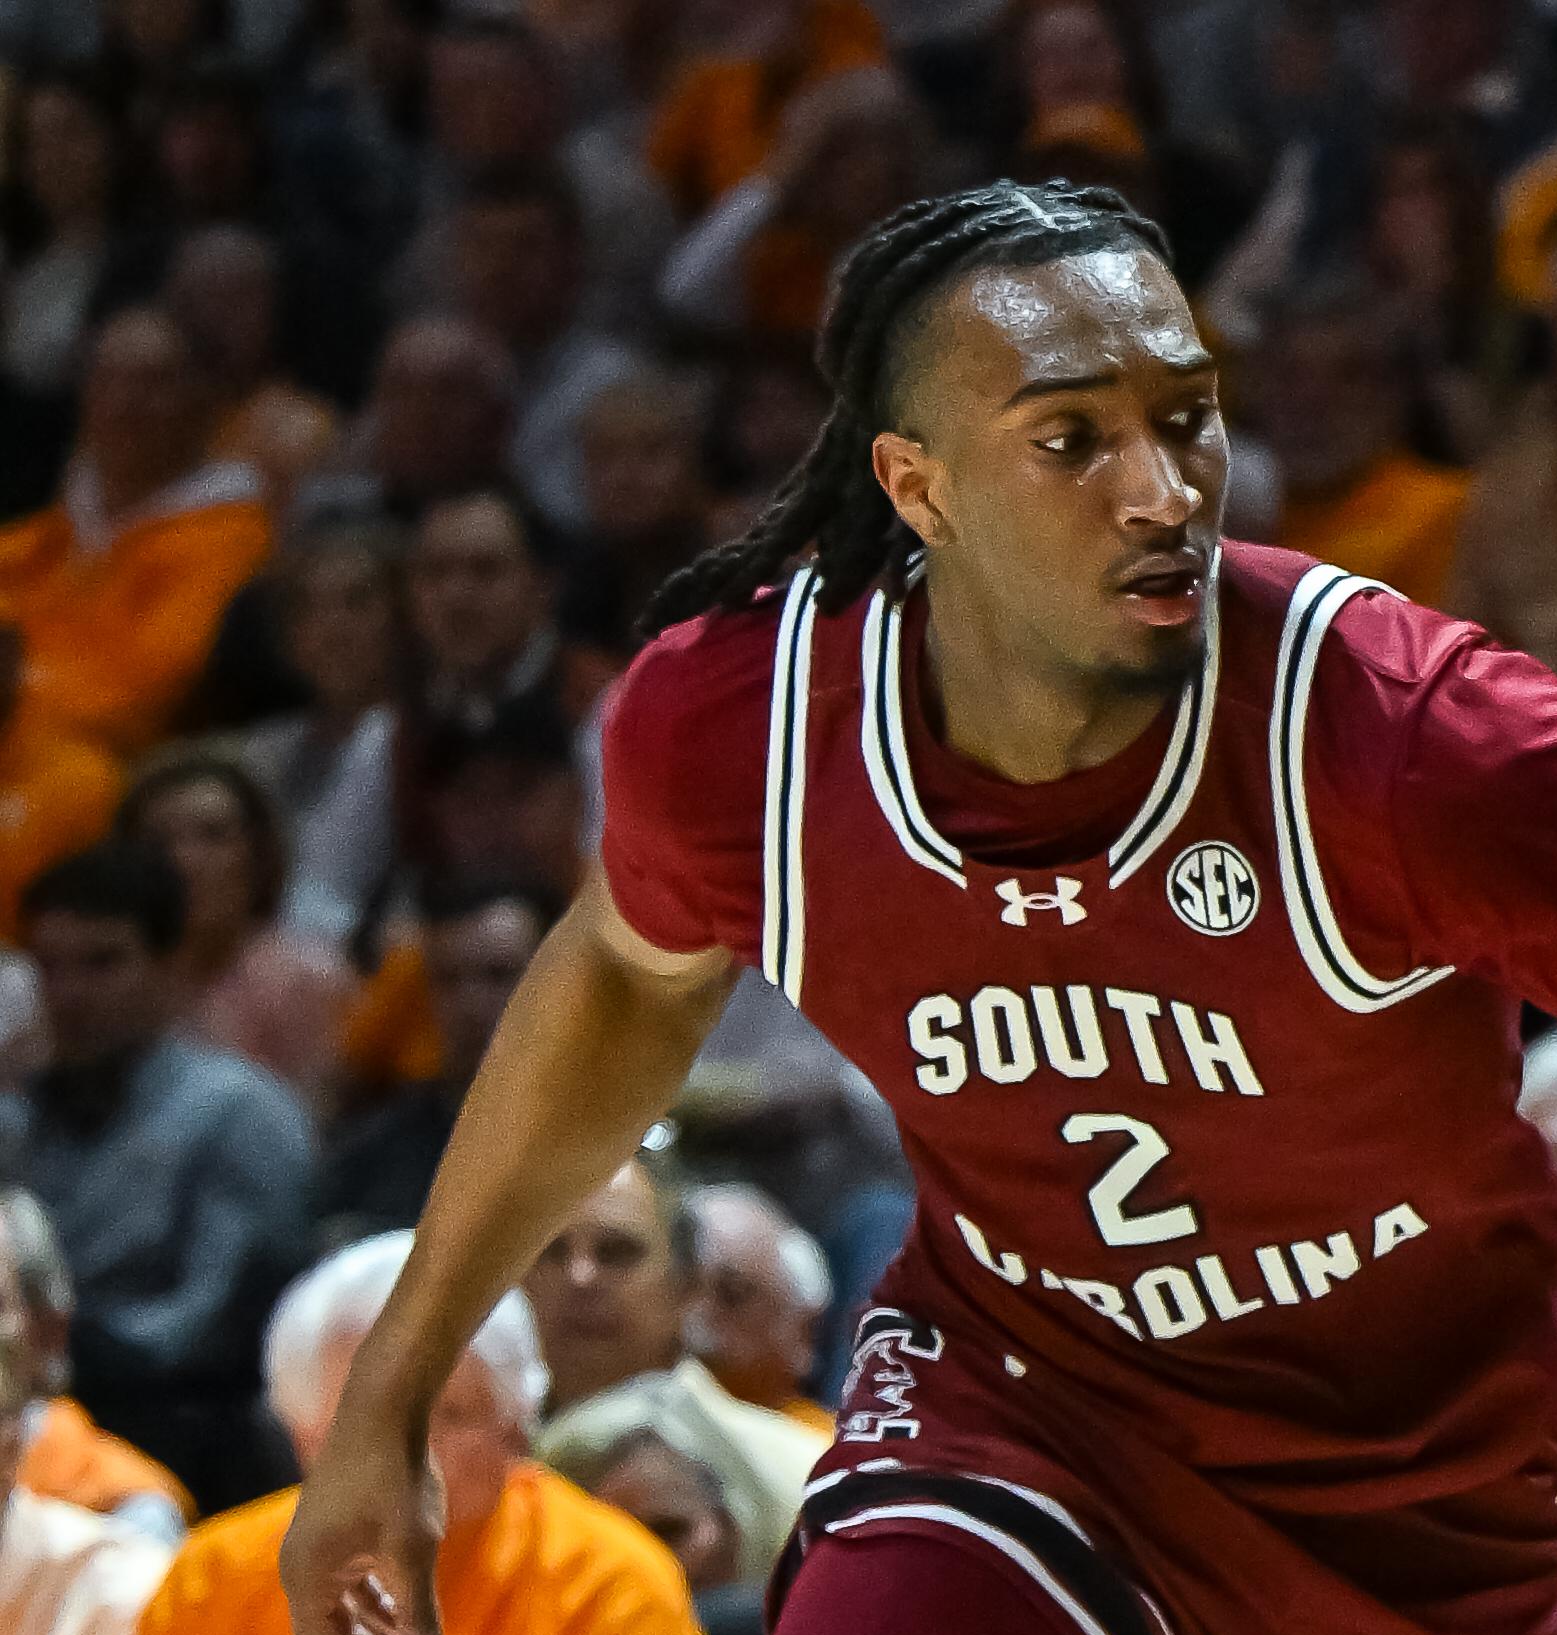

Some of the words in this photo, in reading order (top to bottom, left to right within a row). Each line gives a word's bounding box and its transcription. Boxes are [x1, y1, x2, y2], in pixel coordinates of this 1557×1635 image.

[1175, 848, 1250, 929] SEC
[908, 985, 1264, 1096] SOUTH
[1061, 1113, 1198, 1246] 2
[954, 1203, 1429, 1342] CROLINA
